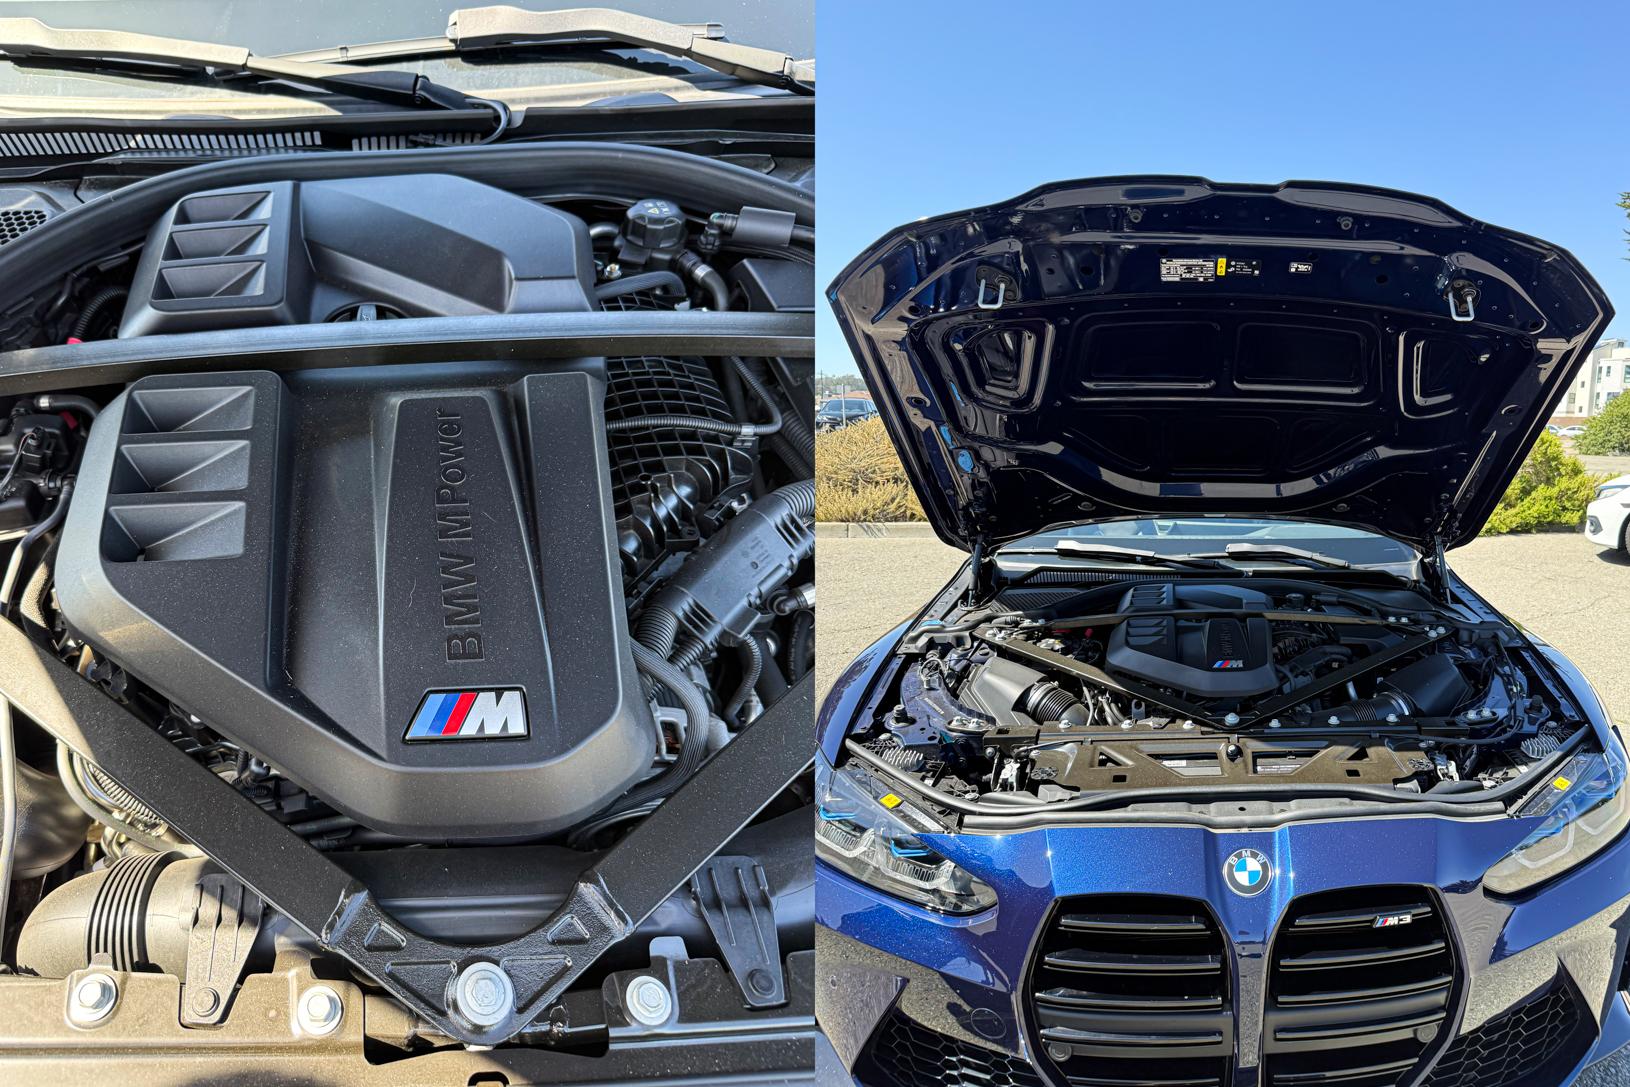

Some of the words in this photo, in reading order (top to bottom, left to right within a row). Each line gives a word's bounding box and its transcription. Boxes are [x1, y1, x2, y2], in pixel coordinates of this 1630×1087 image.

[438, 551, 485, 663] BMW
[458, 691, 529, 736] M
[1228, 850, 1267, 865] BMW
[1385, 915, 1411, 926] M3
